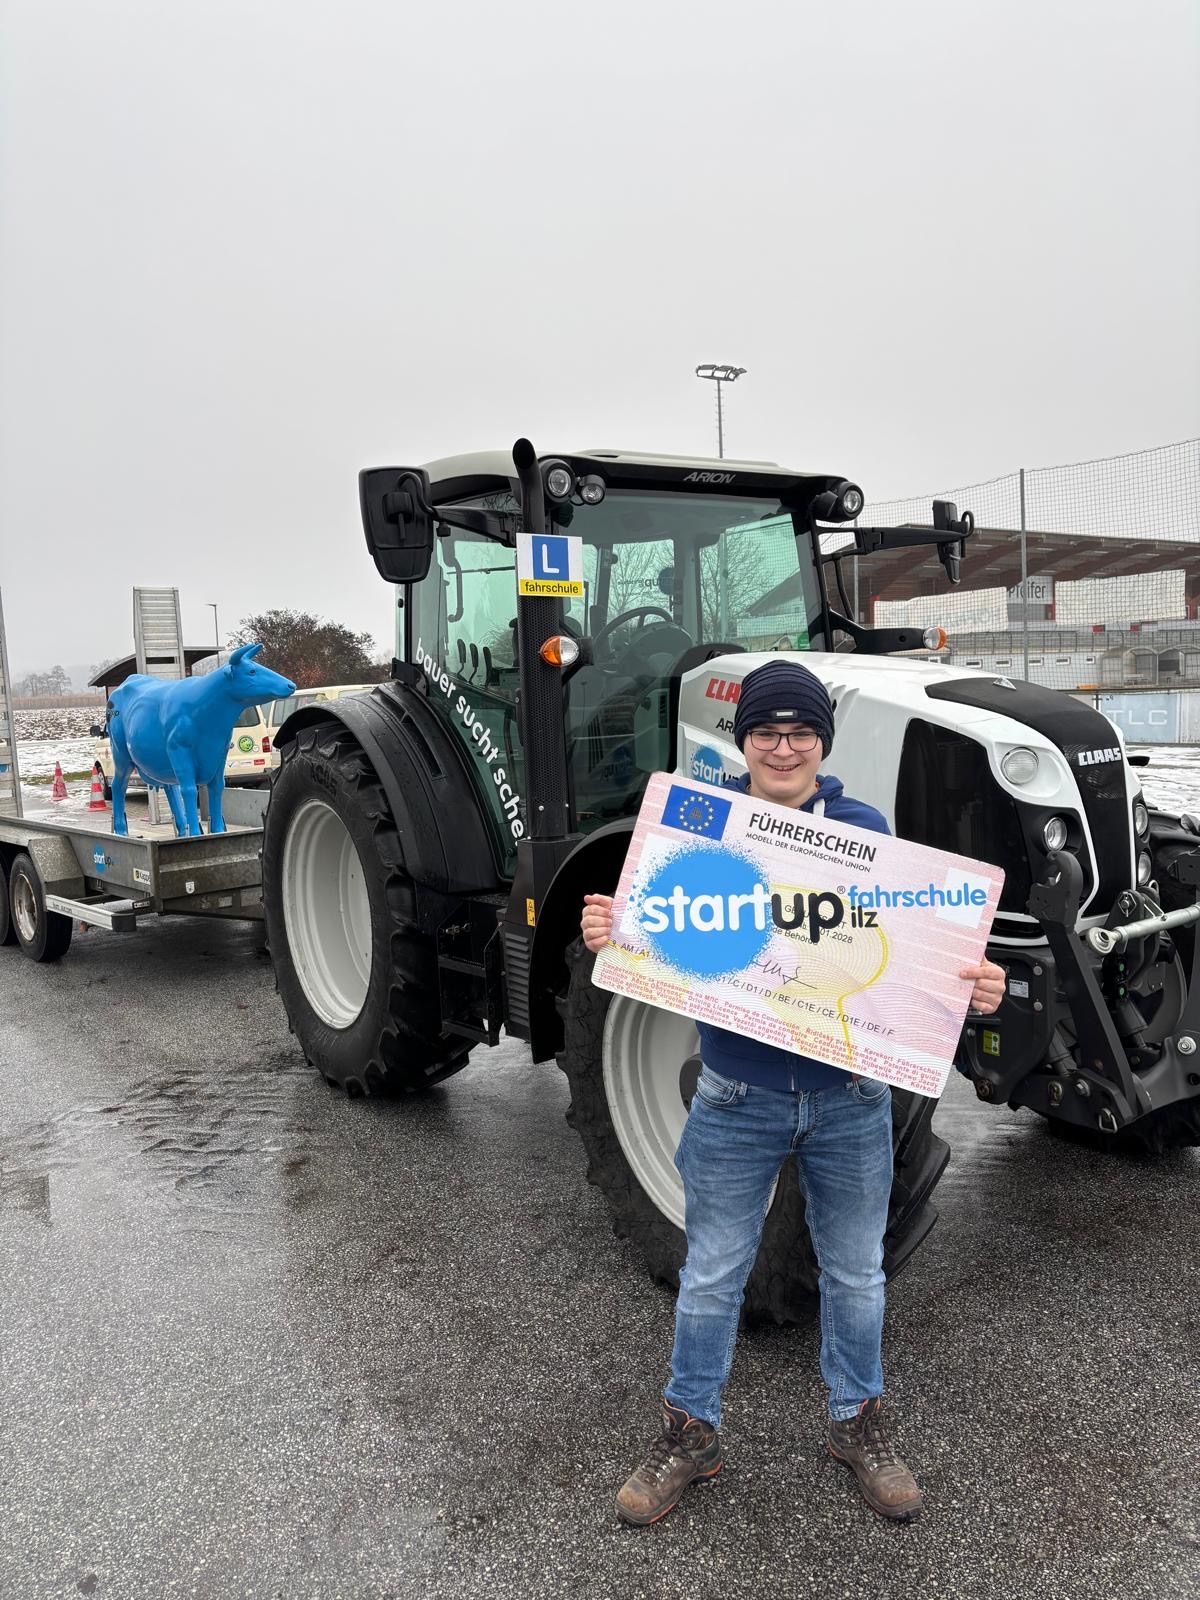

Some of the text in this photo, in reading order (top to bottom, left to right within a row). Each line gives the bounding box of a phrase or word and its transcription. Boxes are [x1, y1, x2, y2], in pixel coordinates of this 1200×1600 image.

[683, 471, 736, 484] ARION
[542, 543, 560, 574] L
[525, 581, 579, 594] fahrschule
[705, 678, 743, 704] CLA
[1106, 709, 1168, 725] TLC
[415, 637, 525, 846] bauer sucht sche
[1078, 747, 1121, 766] CLAAS
[748, 812, 877, 863] FÜHRERSCHEIN
[745, 831, 871, 872] MODELL DER EUROPÄISCHEN UNION
[848, 882, 987, 909] fahrschule
[851, 906, 879, 929] ilz
[620, 942, 633, 952] AM
[733, 979, 739, 987] C
[746, 983, 757, 992] D1
[764, 989, 771, 997] D
[778, 993, 790, 1003] BE
[797, 1000, 815, 1011] C1E
[821, 1008, 834, 1018] CE
[841, 1014, 859, 1026] D1E
[866, 1022, 880, 1033] DE
[887, 1029, 894, 1037] F
